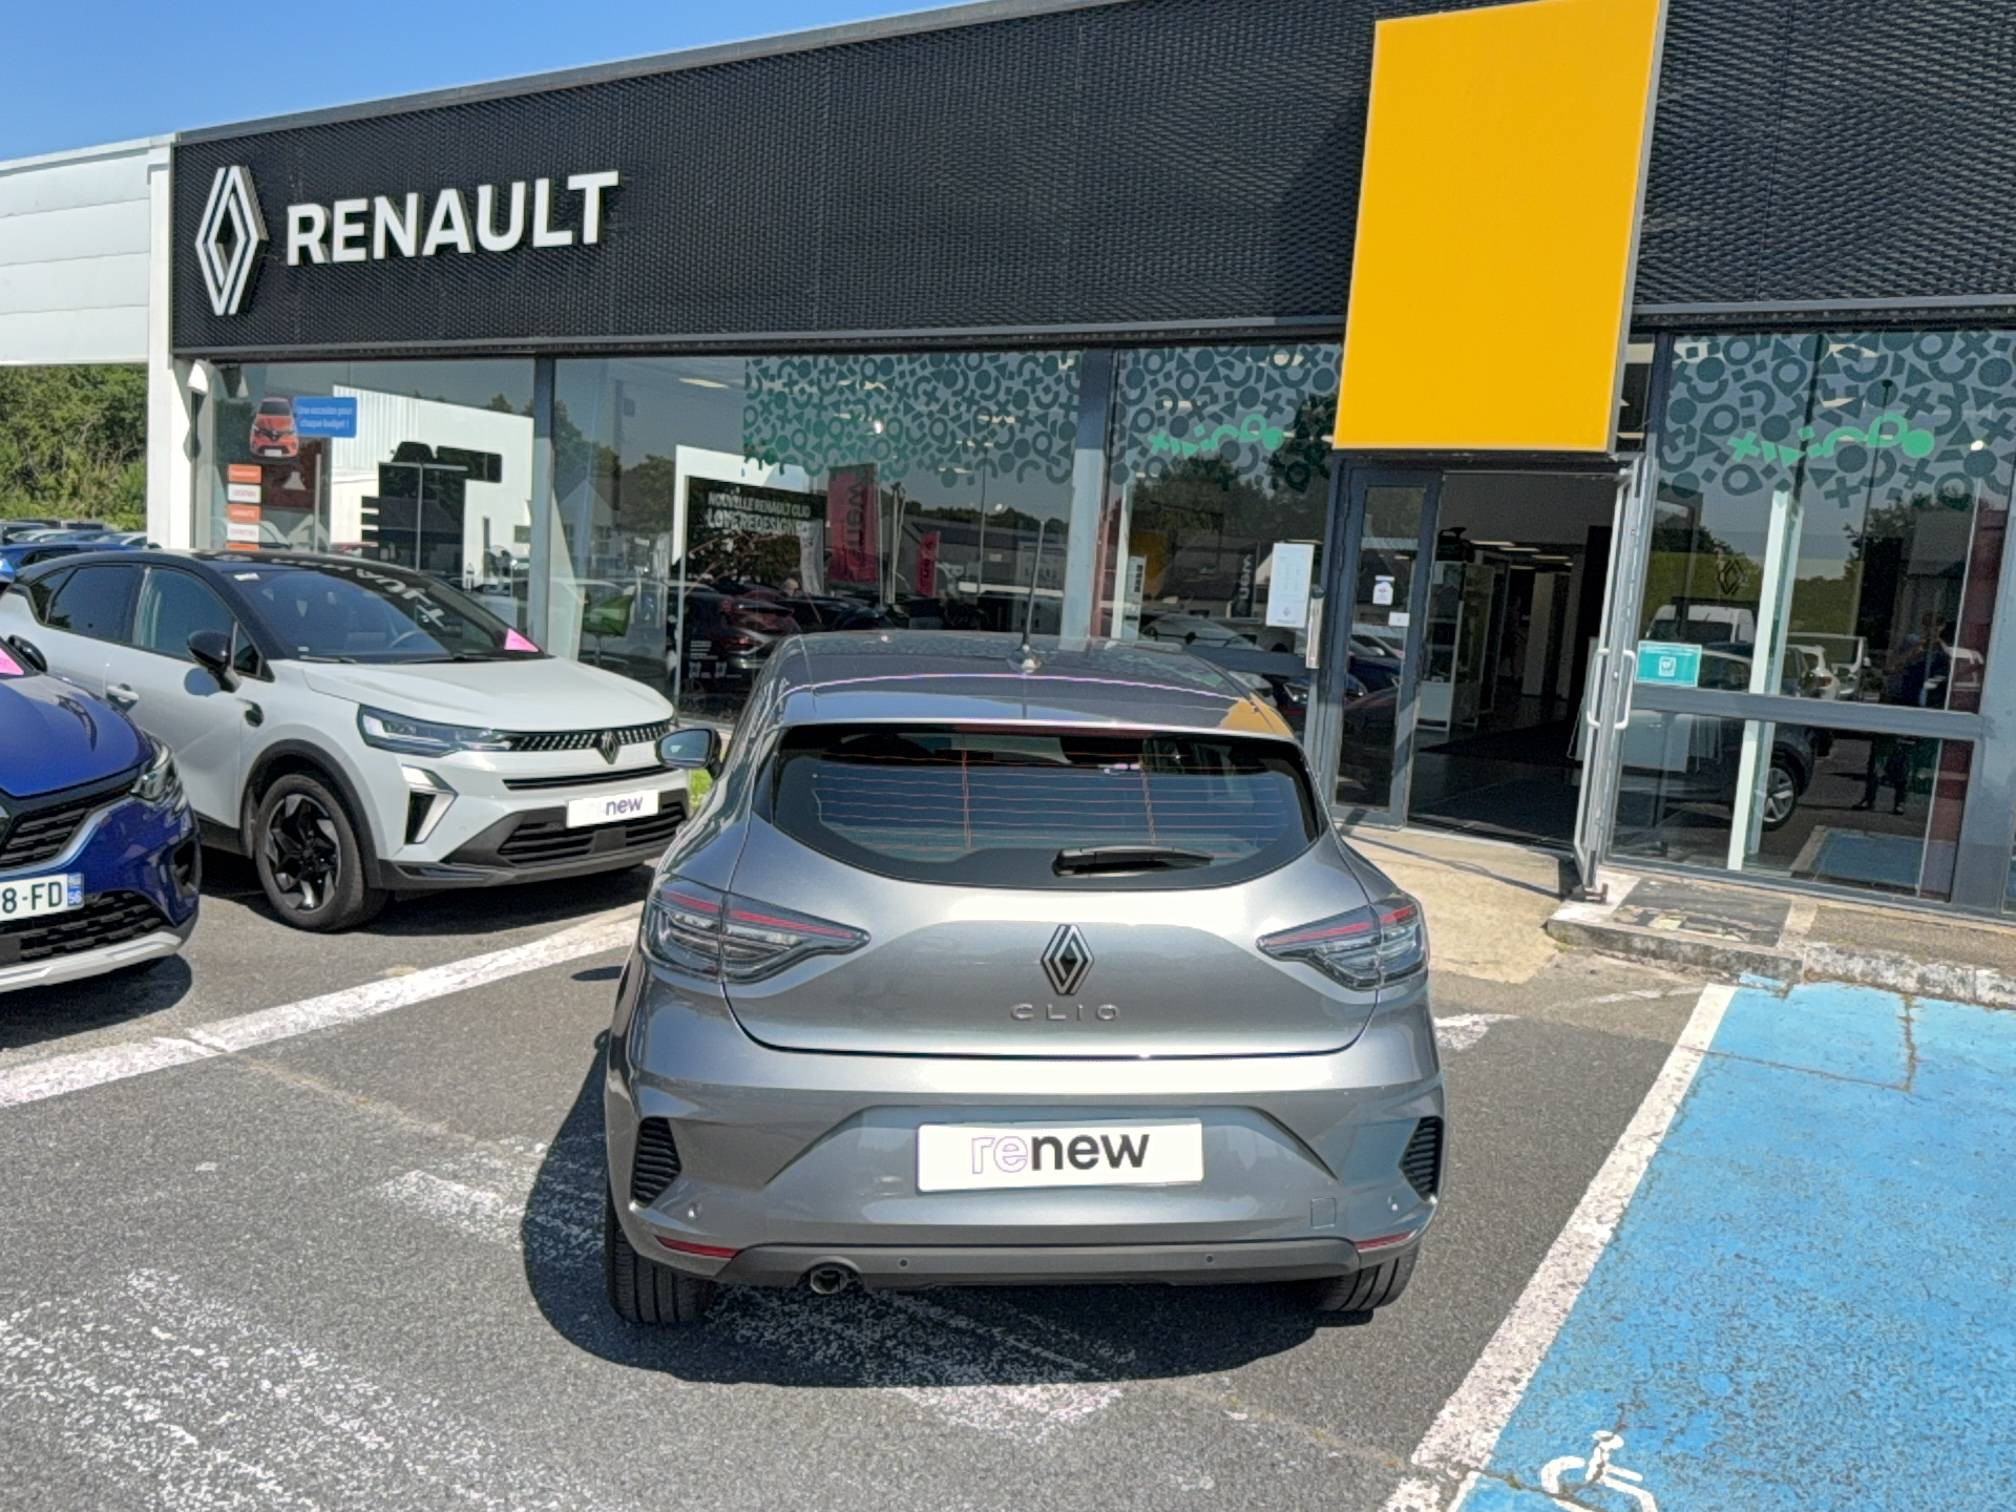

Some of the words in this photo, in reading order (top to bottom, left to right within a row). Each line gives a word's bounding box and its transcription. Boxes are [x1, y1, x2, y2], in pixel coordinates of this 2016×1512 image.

[287, 170, 619, 266] RENAULT
[754, 499, 791, 516] RENAULT
[2, 881, 62, 914] 8-FD
[1010, 1003, 1120, 1021] CLIO
[971, 1133, 1150, 1175] renew
